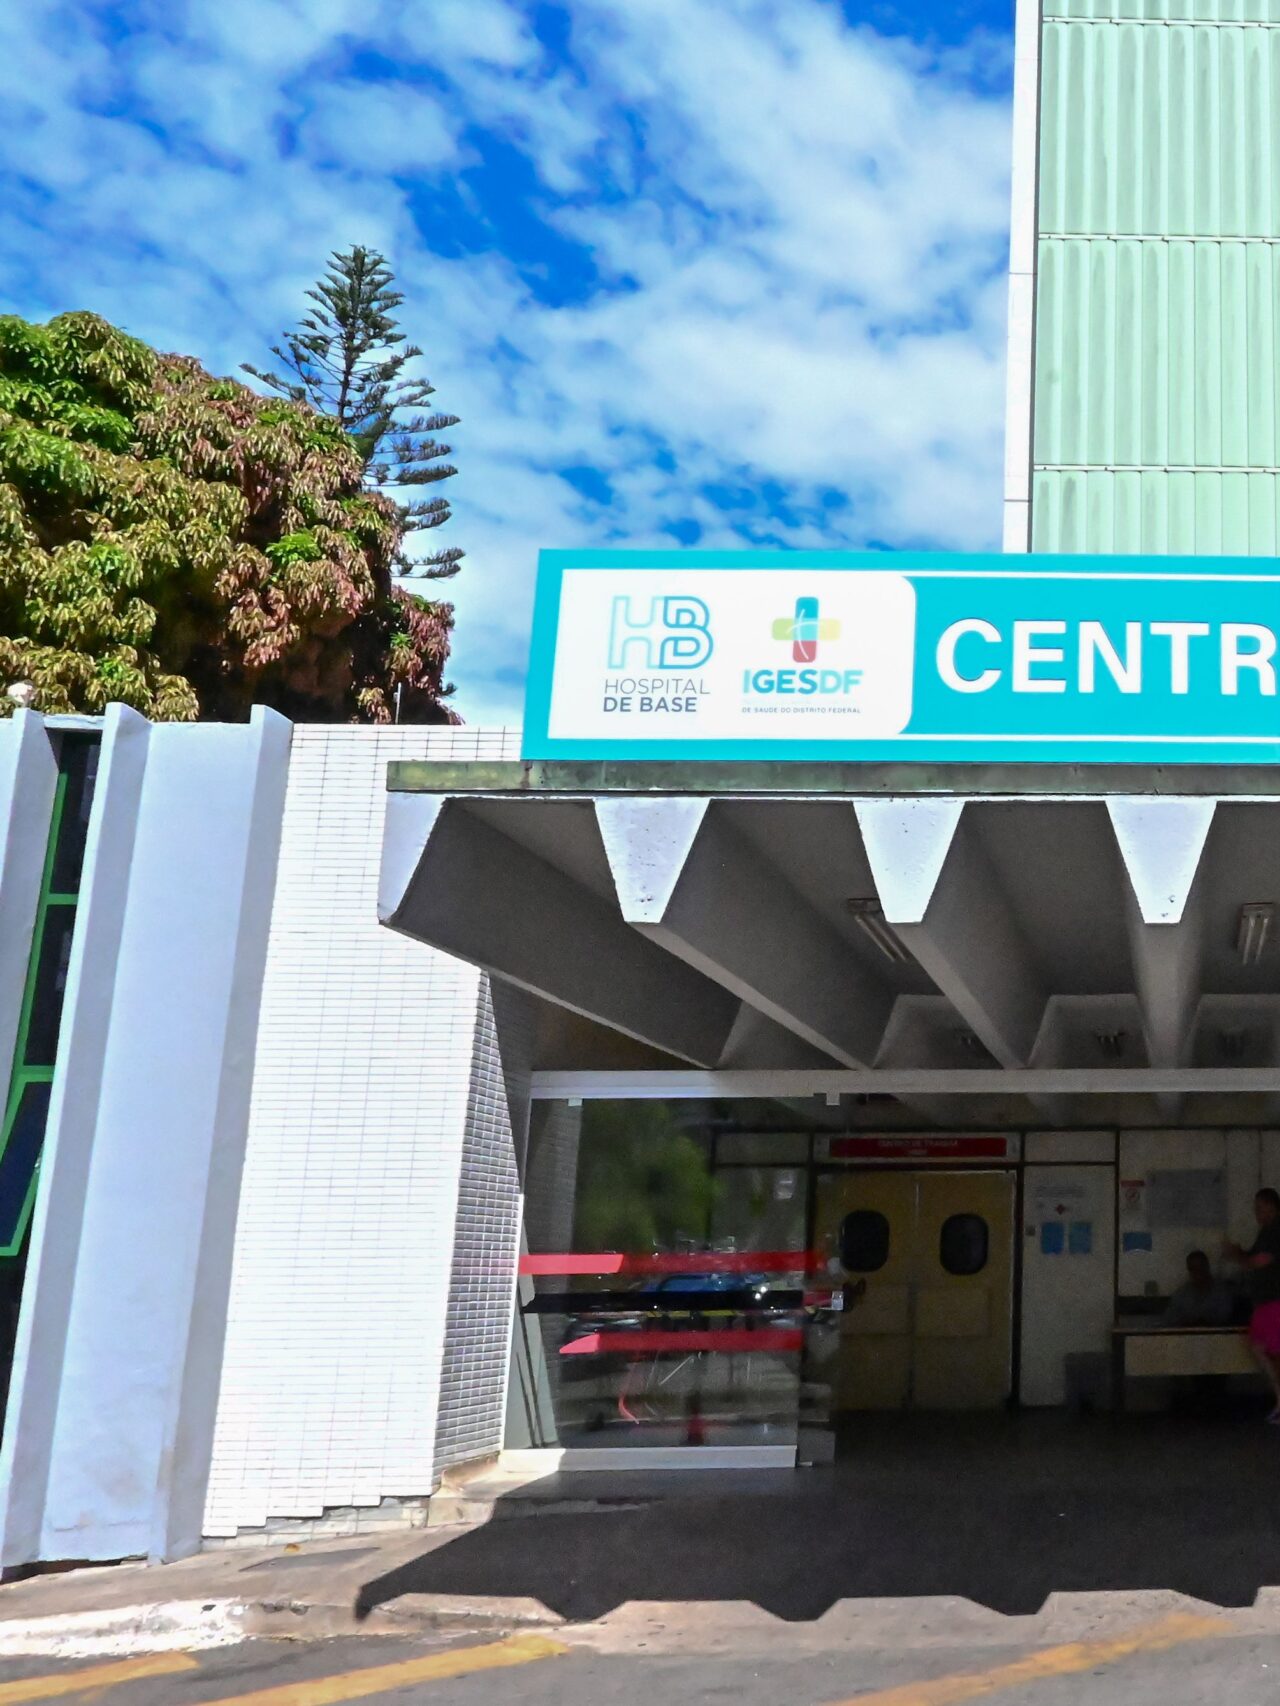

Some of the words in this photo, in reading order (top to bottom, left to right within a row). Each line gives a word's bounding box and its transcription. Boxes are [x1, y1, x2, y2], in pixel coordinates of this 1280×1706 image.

[607, 595, 714, 670] HB
[604, 678, 711, 695] HOSPITAL
[741, 668, 864, 695] IGESDF
[602, 696, 633, 713] DE
[639, 696, 698, 713] BASE
[741, 706, 752, 714] DE
[780, 706, 791, 714] DO
[793, 706, 826, 714] DISTRITO
[828, 706, 862, 714] FEDERAL
